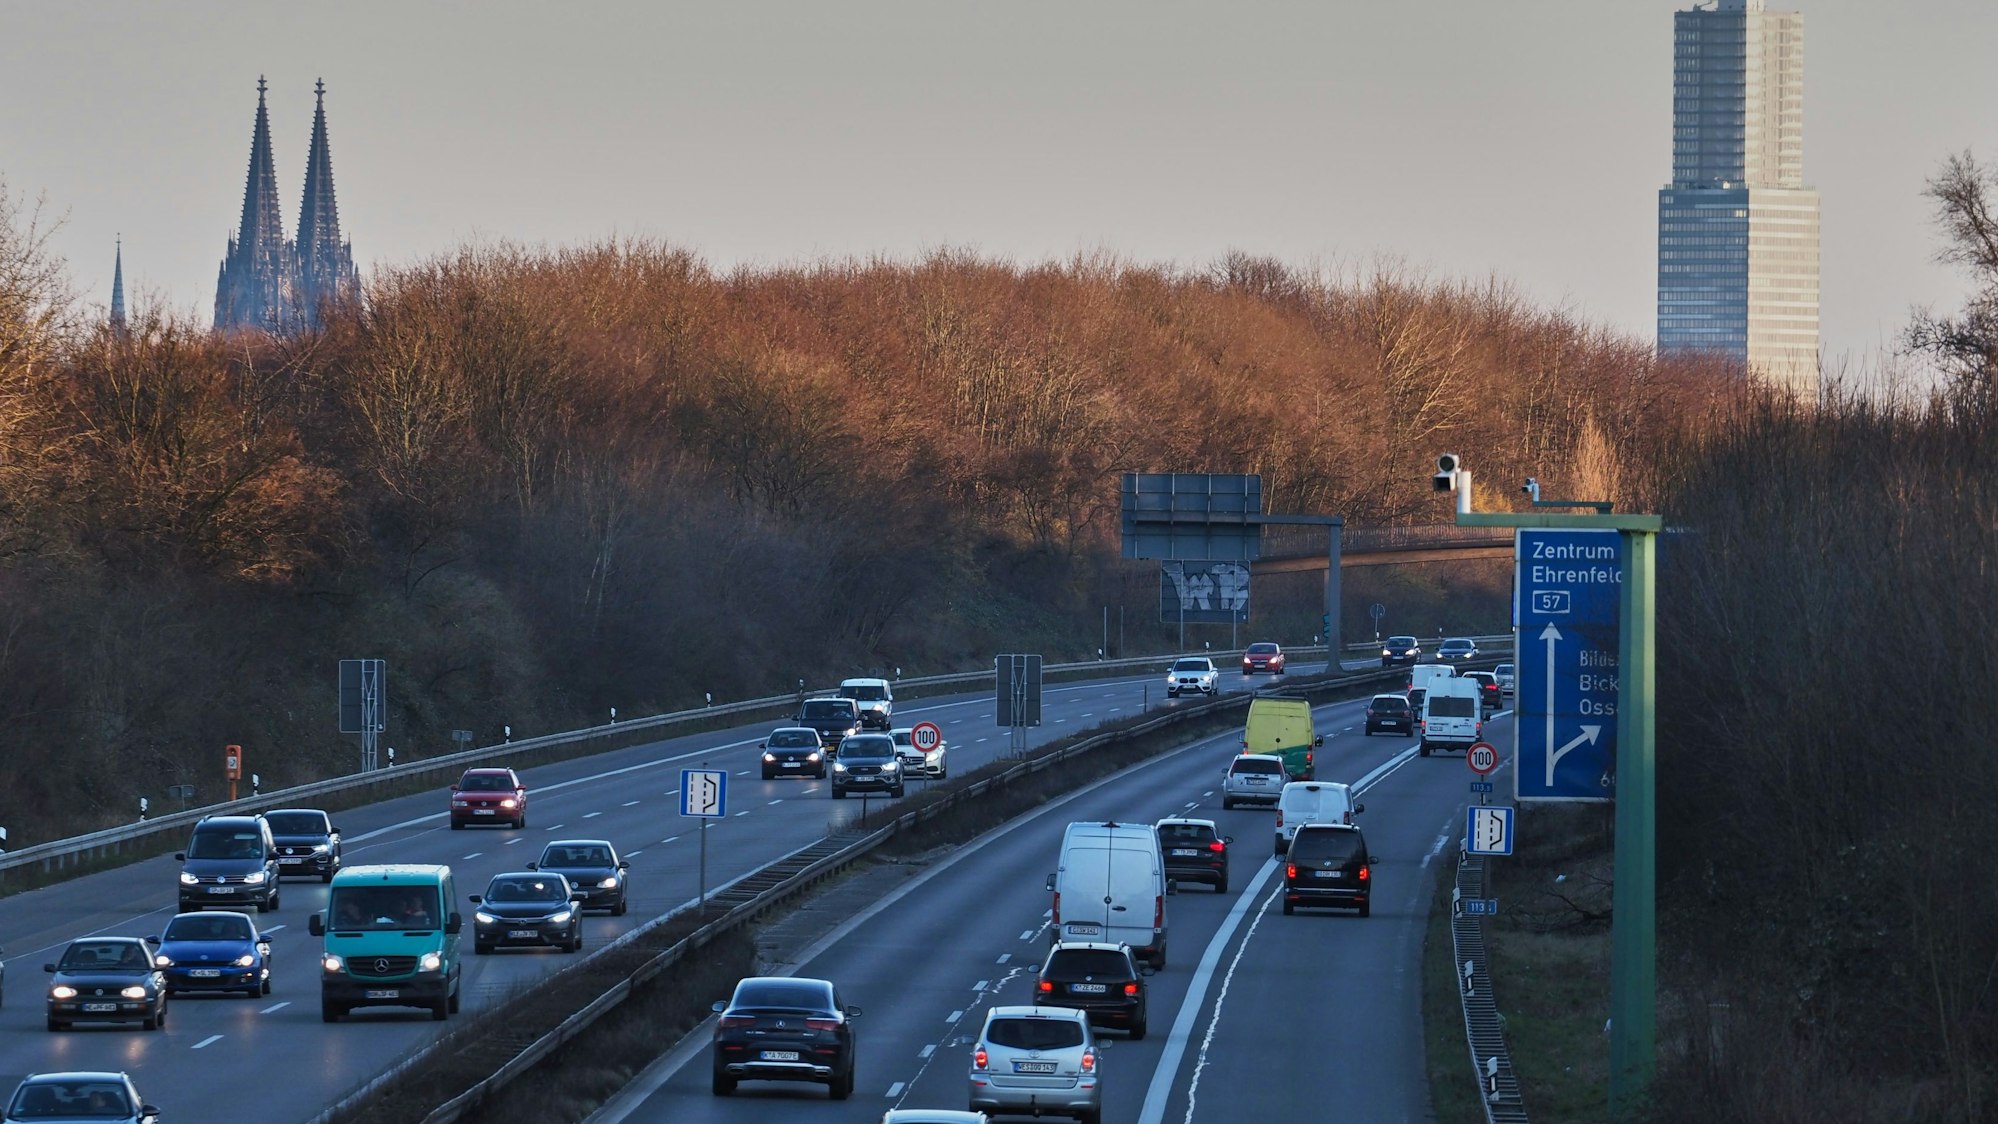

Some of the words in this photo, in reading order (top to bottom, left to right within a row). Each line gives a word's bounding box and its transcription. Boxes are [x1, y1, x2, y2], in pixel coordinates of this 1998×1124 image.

[1532, 541, 1614, 559] Zentrum
[1543, 595, 1560, 609] 57
[1579, 650, 1620, 667] Bilde
[1579, 698, 1619, 715] Oss
[917, 730, 935, 744] 100
[1473, 751, 1492, 766] 100
[1600, 770, 1616, 787] 6
